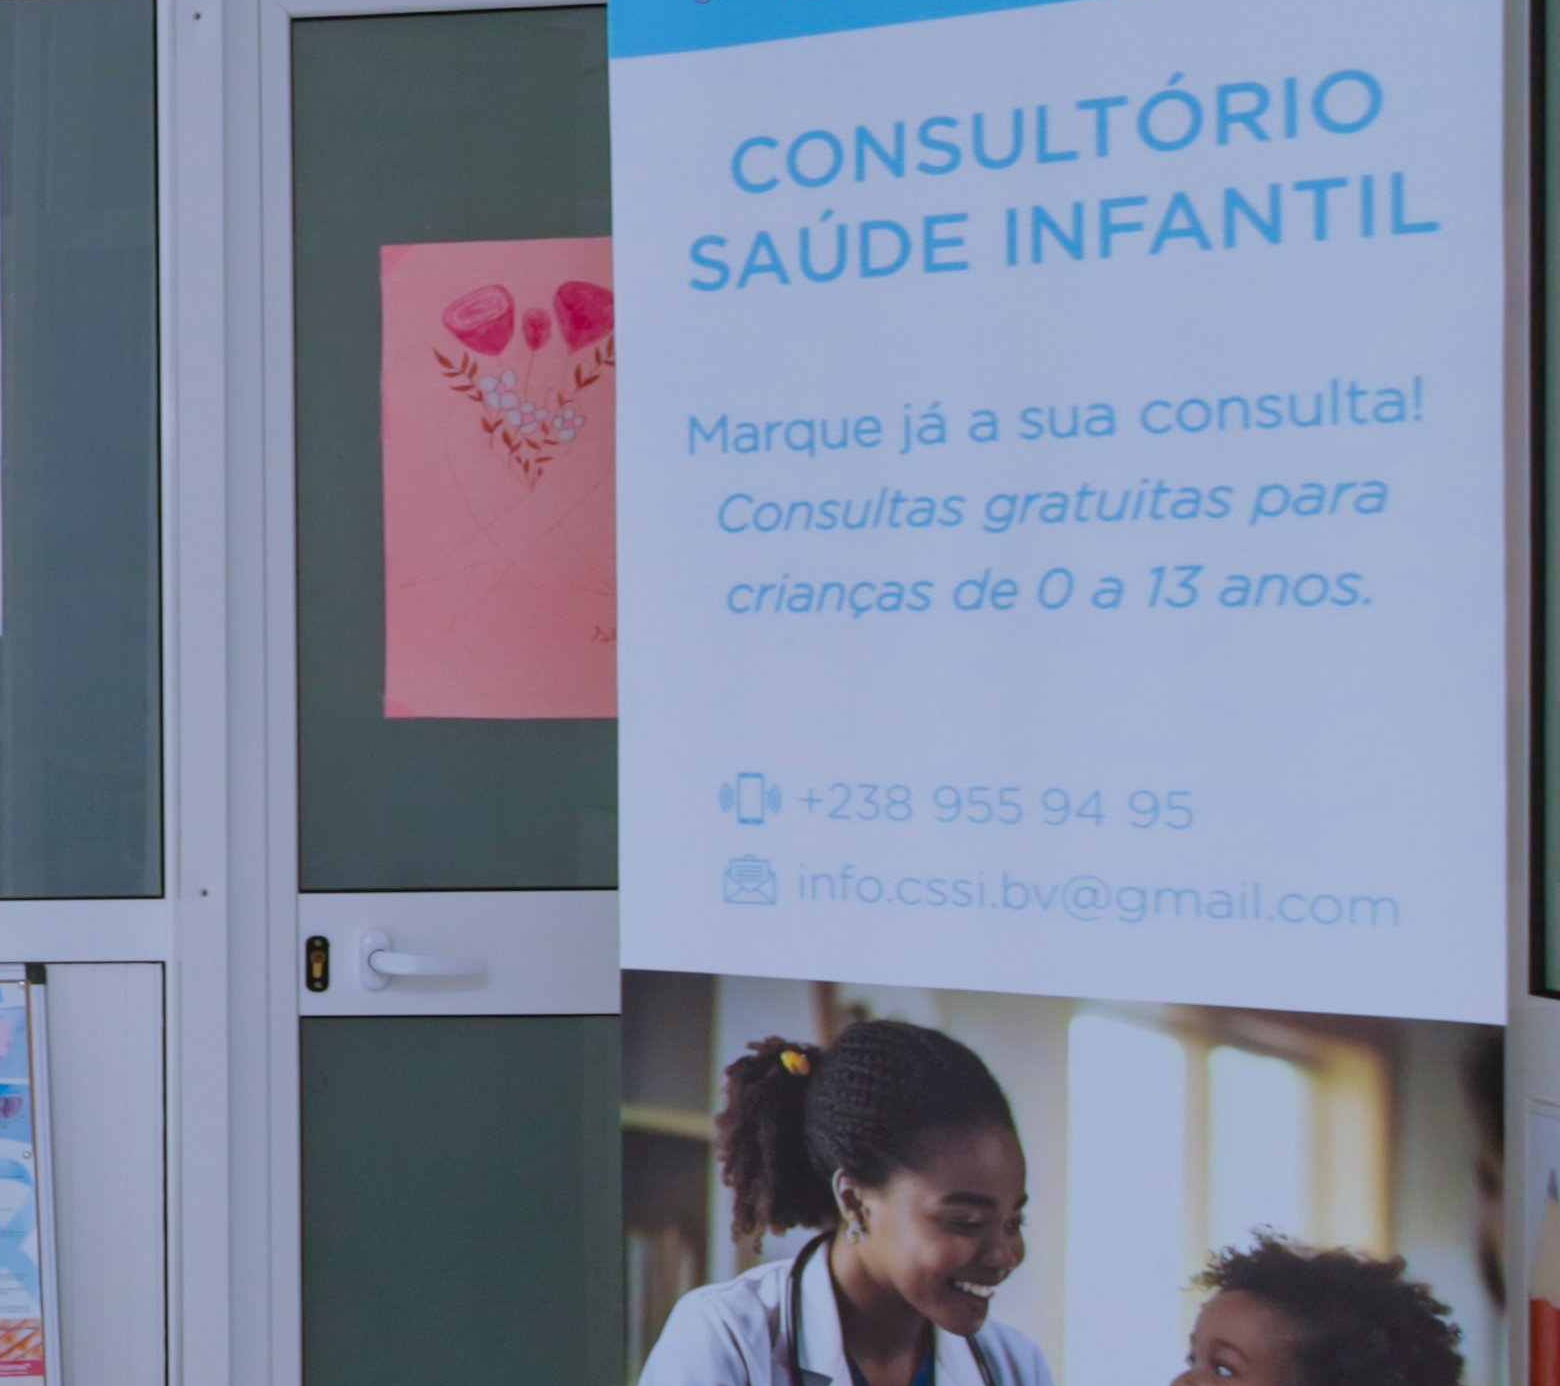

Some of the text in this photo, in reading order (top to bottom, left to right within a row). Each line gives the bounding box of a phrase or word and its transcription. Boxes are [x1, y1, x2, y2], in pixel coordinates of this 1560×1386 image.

[731, 69, 1385, 195] CONSULTÓRIO
[689, 171, 1441, 292] SAÚDE INFANTIL
[687, 375, 1426, 459] Marque já a sua consulta!
[717, 475, 1390, 534] Consultas gratuitas para
[725, 573, 933, 621] crianças
[952, 568, 1019, 611] de
[1090, 574, 1125, 610] a
[1148, 565, 1206, 610] 13
[1217, 569, 1374, 609] anos.
[798, 781, 1196, 831] +238 955 94 95
[798, 862, 1403, 930] info.cssi.bv@gmail.com
